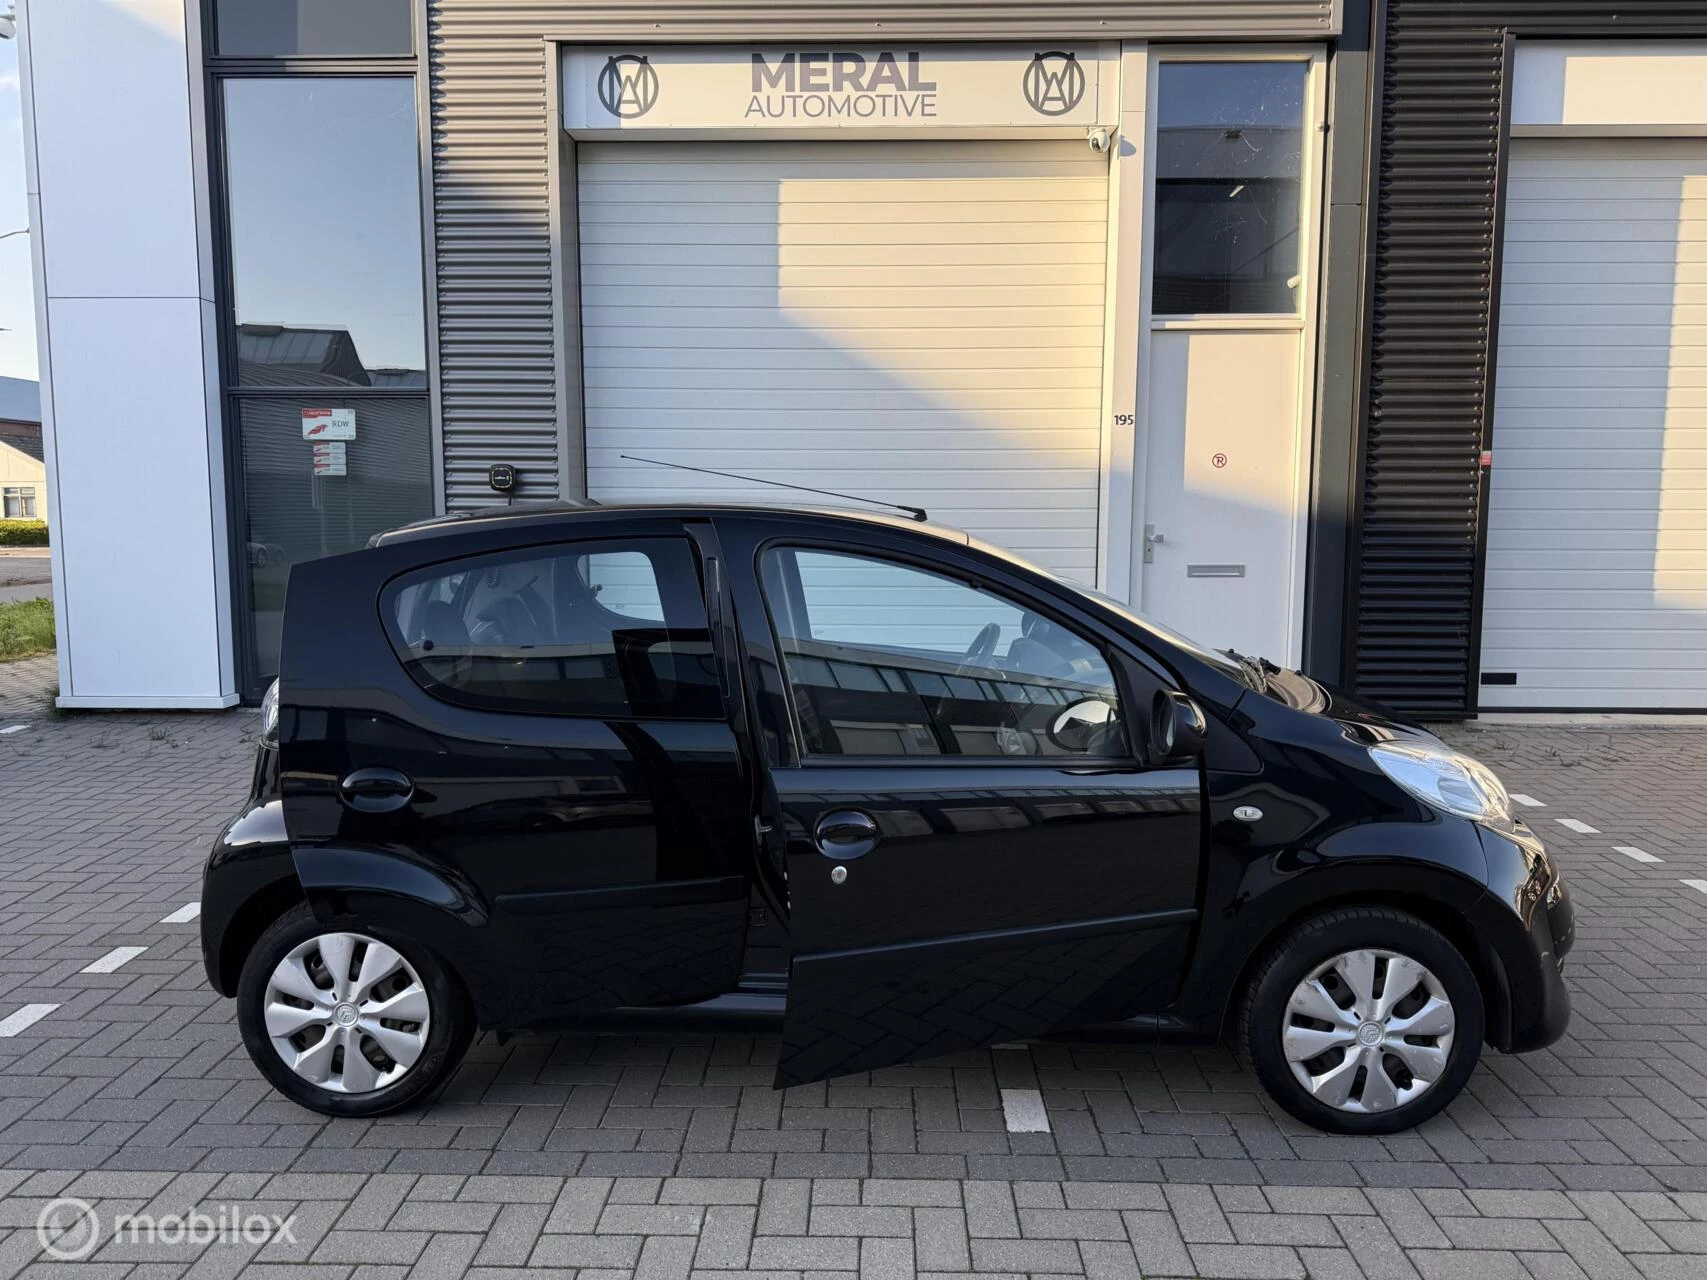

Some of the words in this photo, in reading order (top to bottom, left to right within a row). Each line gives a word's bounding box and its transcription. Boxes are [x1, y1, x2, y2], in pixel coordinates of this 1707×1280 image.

[752, 52, 936, 92] MERAL
[744, 94, 936, 118] AUTOMOTIVE
[1114, 414, 1134, 426] 195
